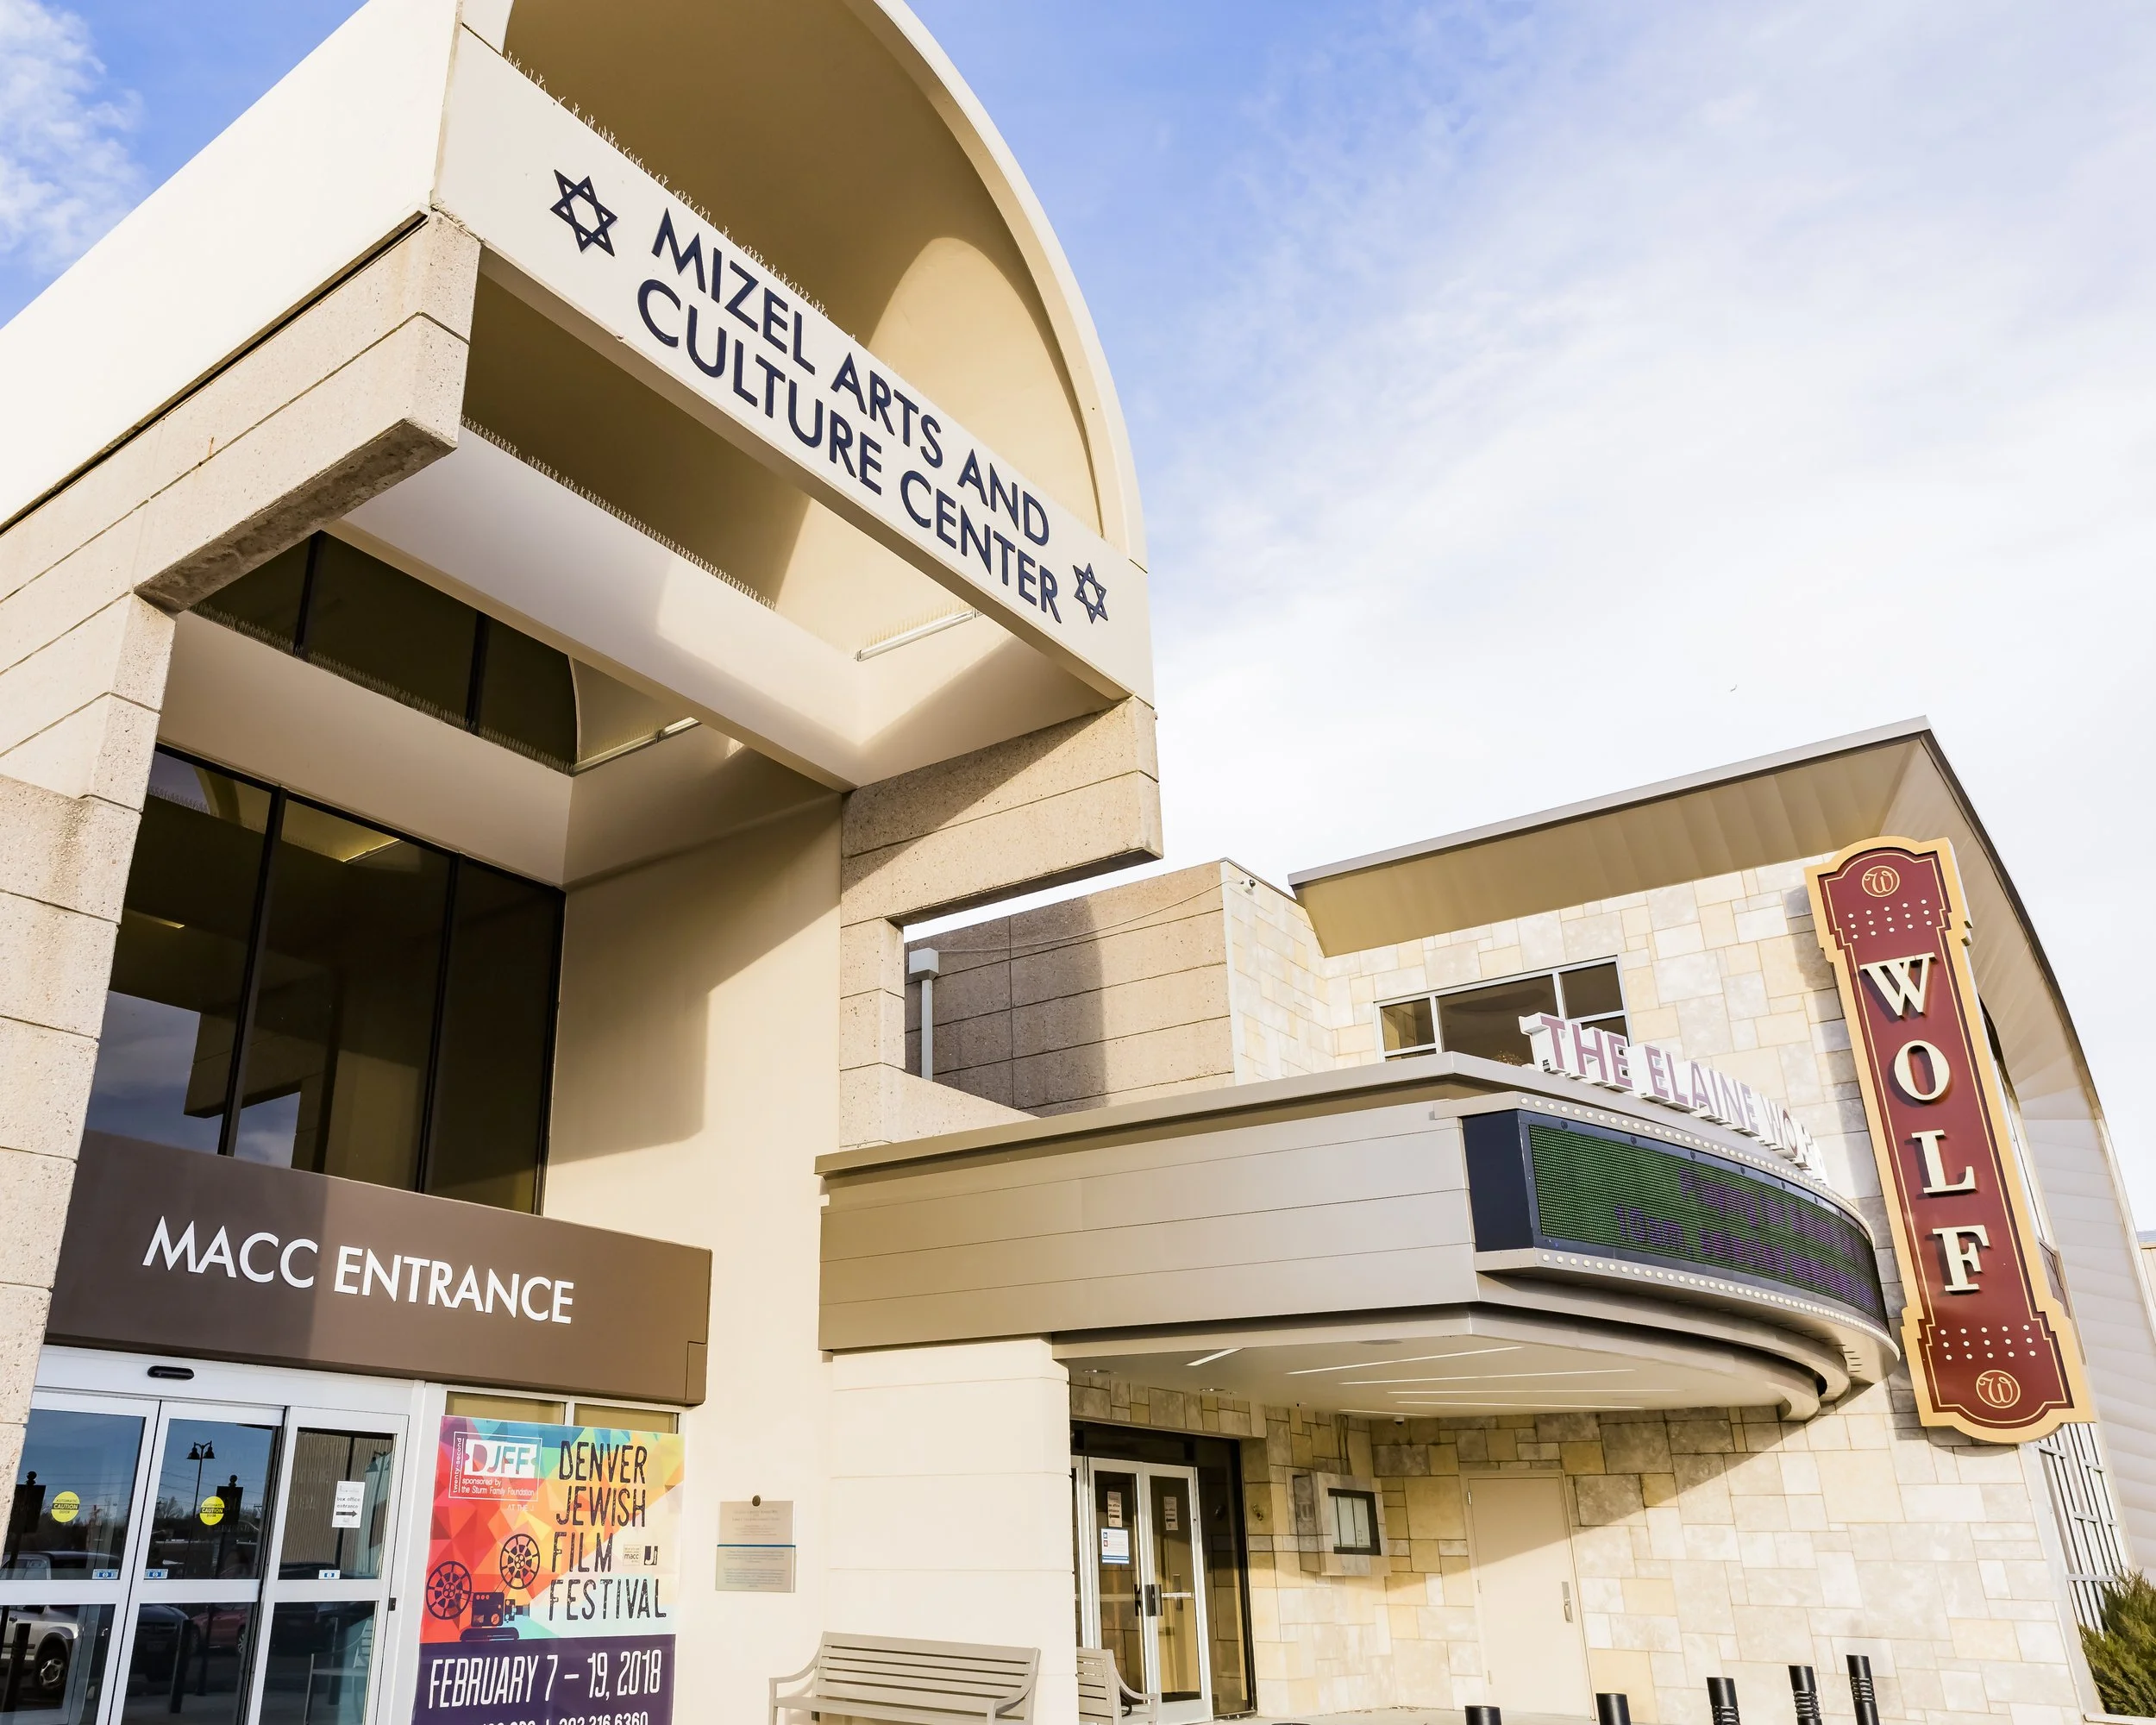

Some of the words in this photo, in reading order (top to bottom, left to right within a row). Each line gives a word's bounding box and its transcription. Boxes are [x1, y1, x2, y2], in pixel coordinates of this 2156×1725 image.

[651, 207, 817, 375] MIZEL
[830, 352, 943, 469] ARTS
[956, 448, 1050, 547] AND
[637, 278, 883, 497] CULTURE
[899, 468, 1063, 624] CENTER
[1536, 1014, 1633, 1090] THE
[1644, 1042, 1760, 1135] ELAINE
[1859, 951, 1990, 1292] WOLF
[141, 1216, 317, 1289] MACC
[334, 1245, 575, 1326] ENTRANCE
[453, 1438, 461, 1493] twenty-second
[461, 1477, 492, 1486] sponsored
[473, 1444, 530, 1474] DJFF
[559, 1440, 648, 1484] DENVER
[472, 1485, 487, 1495] Sturm
[489, 1486, 506, 1496] Family
[507, 1487, 535, 1496] Foundation
[555, 1485, 646, 1527] JEWISH
[551, 1532, 613, 1572] FILM
[548, 1578, 667, 1621] FESTIVAL
[428, 1654, 539, 1709] FEBRUARY
[545, 1654, 558, 1702] 7
[587, 1652, 611, 1701] 19,
[617, 1649, 661, 1697] 2018
